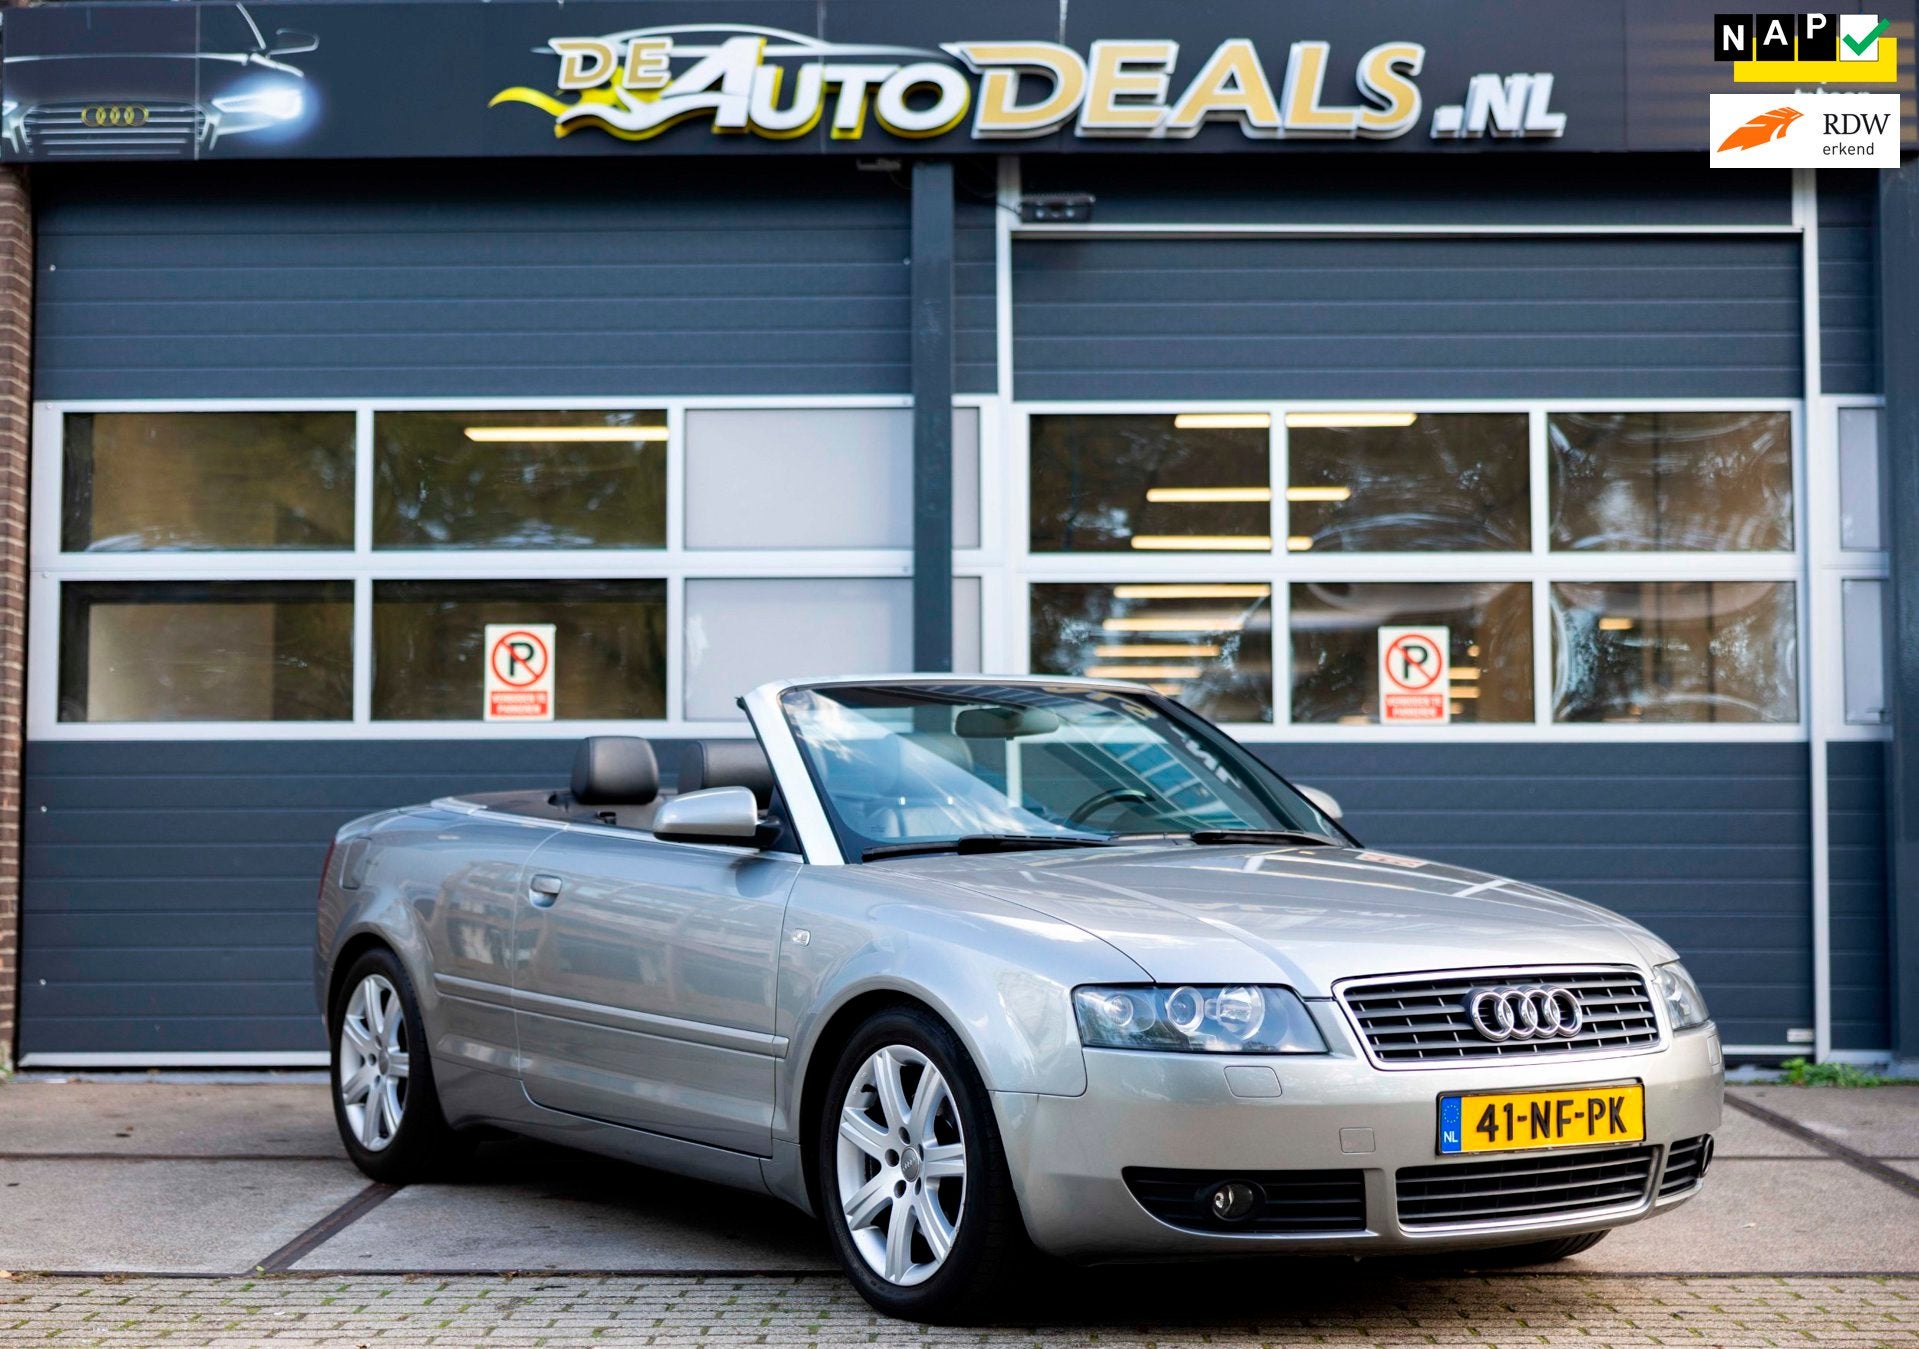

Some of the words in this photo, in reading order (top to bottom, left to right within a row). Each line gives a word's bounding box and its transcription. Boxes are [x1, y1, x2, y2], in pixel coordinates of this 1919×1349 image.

[549, 37, 674, 90] DE
[1443, 1130, 1459, 1143] NL
[1476, 1096, 1628, 1143] 41-NF-PK
